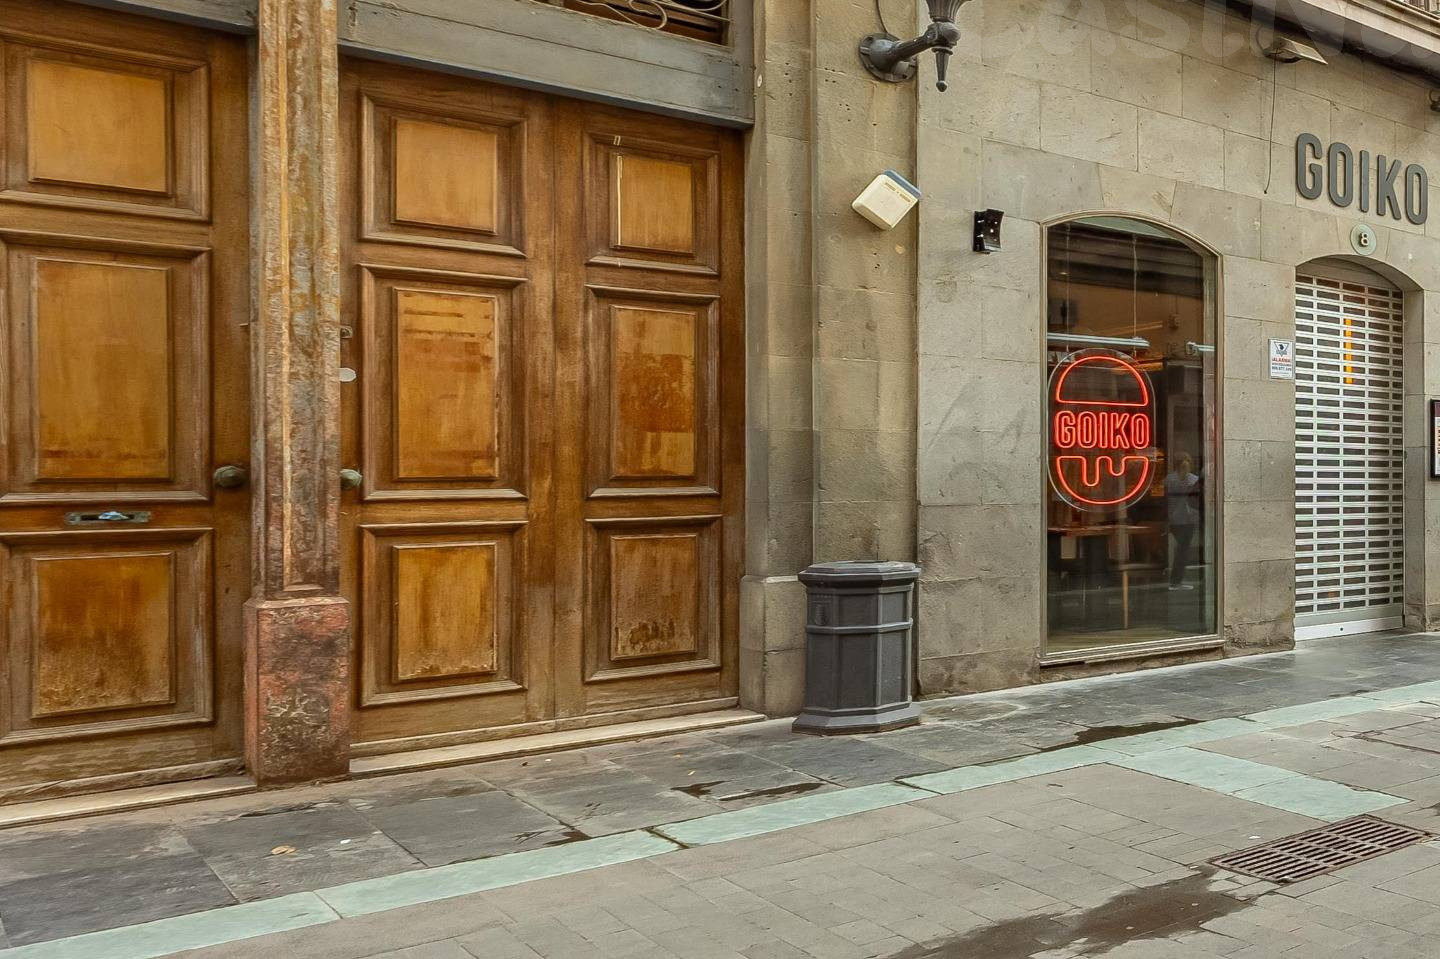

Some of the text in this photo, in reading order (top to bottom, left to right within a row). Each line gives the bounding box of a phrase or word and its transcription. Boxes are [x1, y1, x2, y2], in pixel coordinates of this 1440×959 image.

[1296, 132, 1428, 225] GOIKO
[1359, 231, 1370, 248] 8
[1055, 410, 1150, 450] GOIKO
